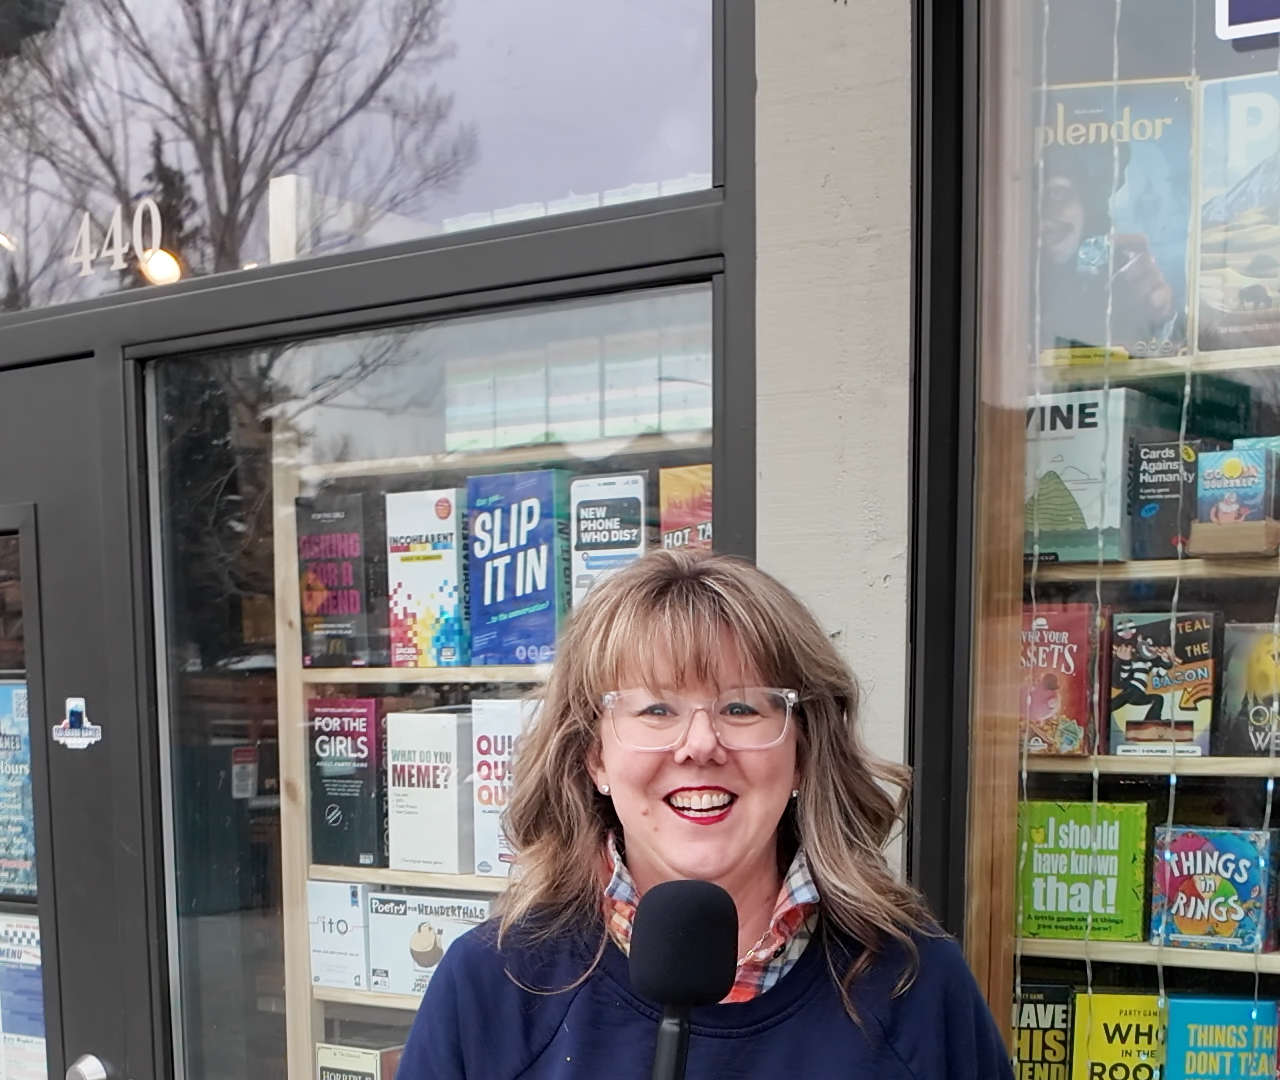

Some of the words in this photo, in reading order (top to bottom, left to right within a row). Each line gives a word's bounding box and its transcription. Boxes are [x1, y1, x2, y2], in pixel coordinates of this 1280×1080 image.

[70, 199, 162, 277] 440
[1140, 448, 1175, 460] Cards
[1140, 472, 1195, 487] Humanty
[580, 506, 607, 519] NEW
[475, 498, 541, 559] SLIP
[580, 517, 621, 532] PHONE
[389, 532, 454, 546] INCOHEARENT
[581, 530, 609, 544] WHO
[611, 528, 639, 542] DIS?
[663, 528, 691, 549] HOT
[342, 561, 353, 586] A
[484, 554, 511, 606] IT
[516, 544, 548, 597] IN
[1043, 630, 1069, 644] YOUR
[1185, 642, 1210, 658] THE
[1151, 667, 1209, 689] BACON
[314, 717, 341, 732] FOR
[342, 717, 367, 732] THE
[314, 735, 369, 759] GIRLS
[391, 749, 417, 763] WHAT
[420, 751, 431, 763] DO
[434, 751, 452, 764] YOU
[391, 764, 452, 790] MEME?
[1033, 848, 1068, 875] have
[1070, 849, 1118, 876] known
[1169, 850, 1252, 884] THINGS
[1199, 874, 1217, 893] in
[1032, 875, 1118, 914] that!
[371, 900, 406, 915] Poetry
[418, 903, 485, 920] NEANDERTHALS
[1170, 894, 1245, 922] RINGS
[322, 917, 348, 936] ito
[1119, 1009, 1141, 1017] PARTY
[1186, 1023, 1249, 1048] THINGS
[1121, 1050, 1132, 1058] IN
[1137, 1050, 1157, 1059] THE
[1185, 1052, 1228, 1075] DON'T
